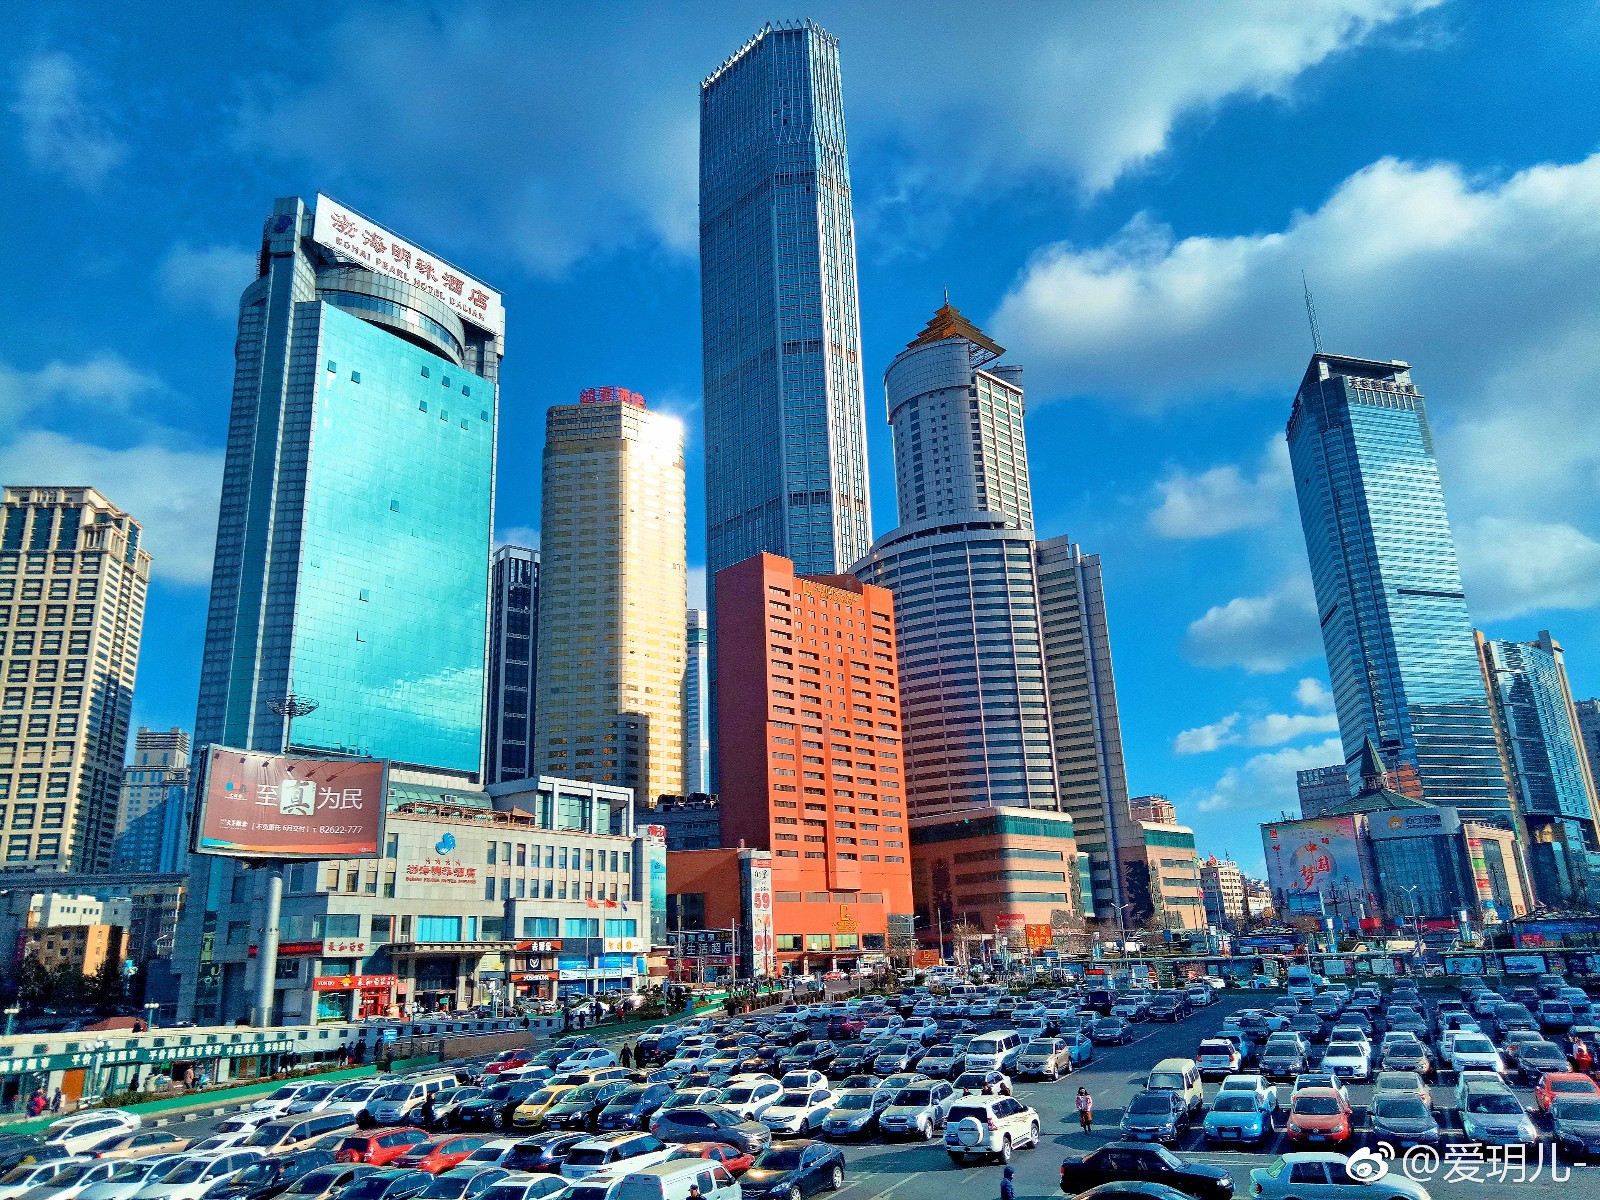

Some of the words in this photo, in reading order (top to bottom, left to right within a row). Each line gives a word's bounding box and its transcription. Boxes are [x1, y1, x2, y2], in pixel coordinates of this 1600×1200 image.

[331, 212, 490, 310] 渤海明珠酒店
[375, 257, 409, 281] PEARL
[413, 277, 446, 301] HOTEL
[449, 296, 485, 321] DALIAN
[255, 779, 363, 816] 至真为民
[319, 825, 363, 834] 82622-777
[753, 892, 771, 910] 59
[532, 941, 552, 952] 吉野家
